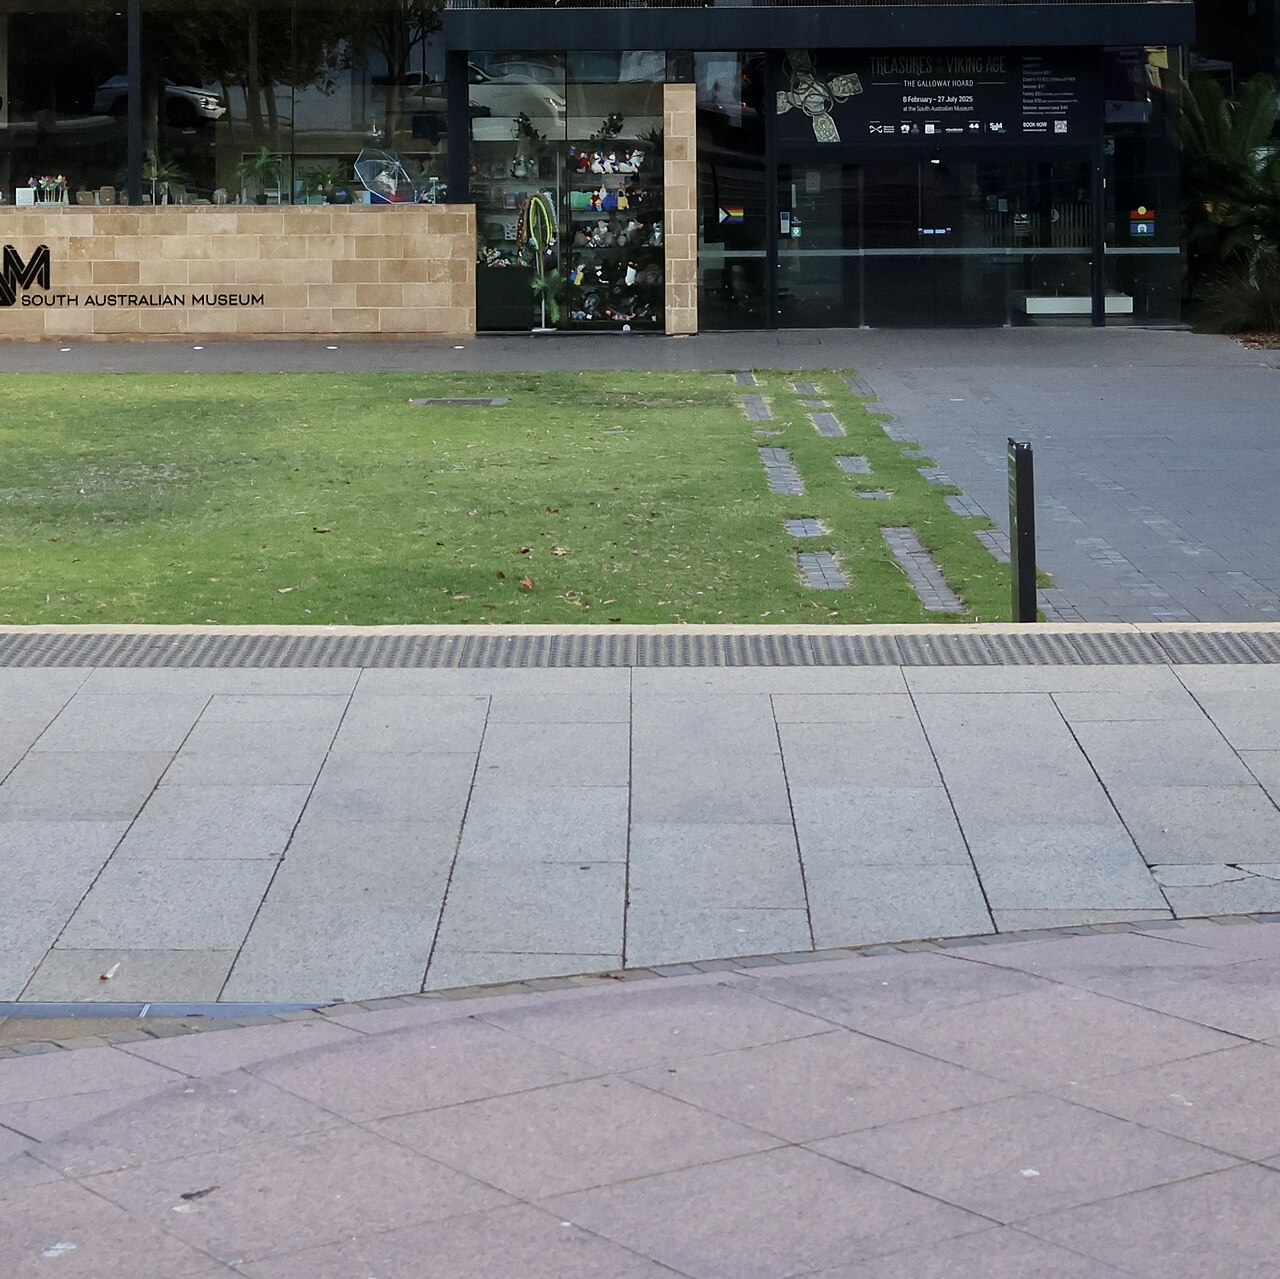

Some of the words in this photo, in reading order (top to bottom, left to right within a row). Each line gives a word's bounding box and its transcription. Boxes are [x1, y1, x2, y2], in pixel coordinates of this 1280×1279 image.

[870, 56, 933, 75] TREASURES
[945, 56, 983, 74] VIKING
[985, 55, 1007, 73] AGE
[908, 95, 933, 104] February
[945, 95, 958, 104] July
[958, 95, 974, 103] 2025
[21, 294, 79, 307] SOUTH
[84, 294, 185, 306] AUSTRALIAN
[191, 294, 265, 306] MUSEUM
